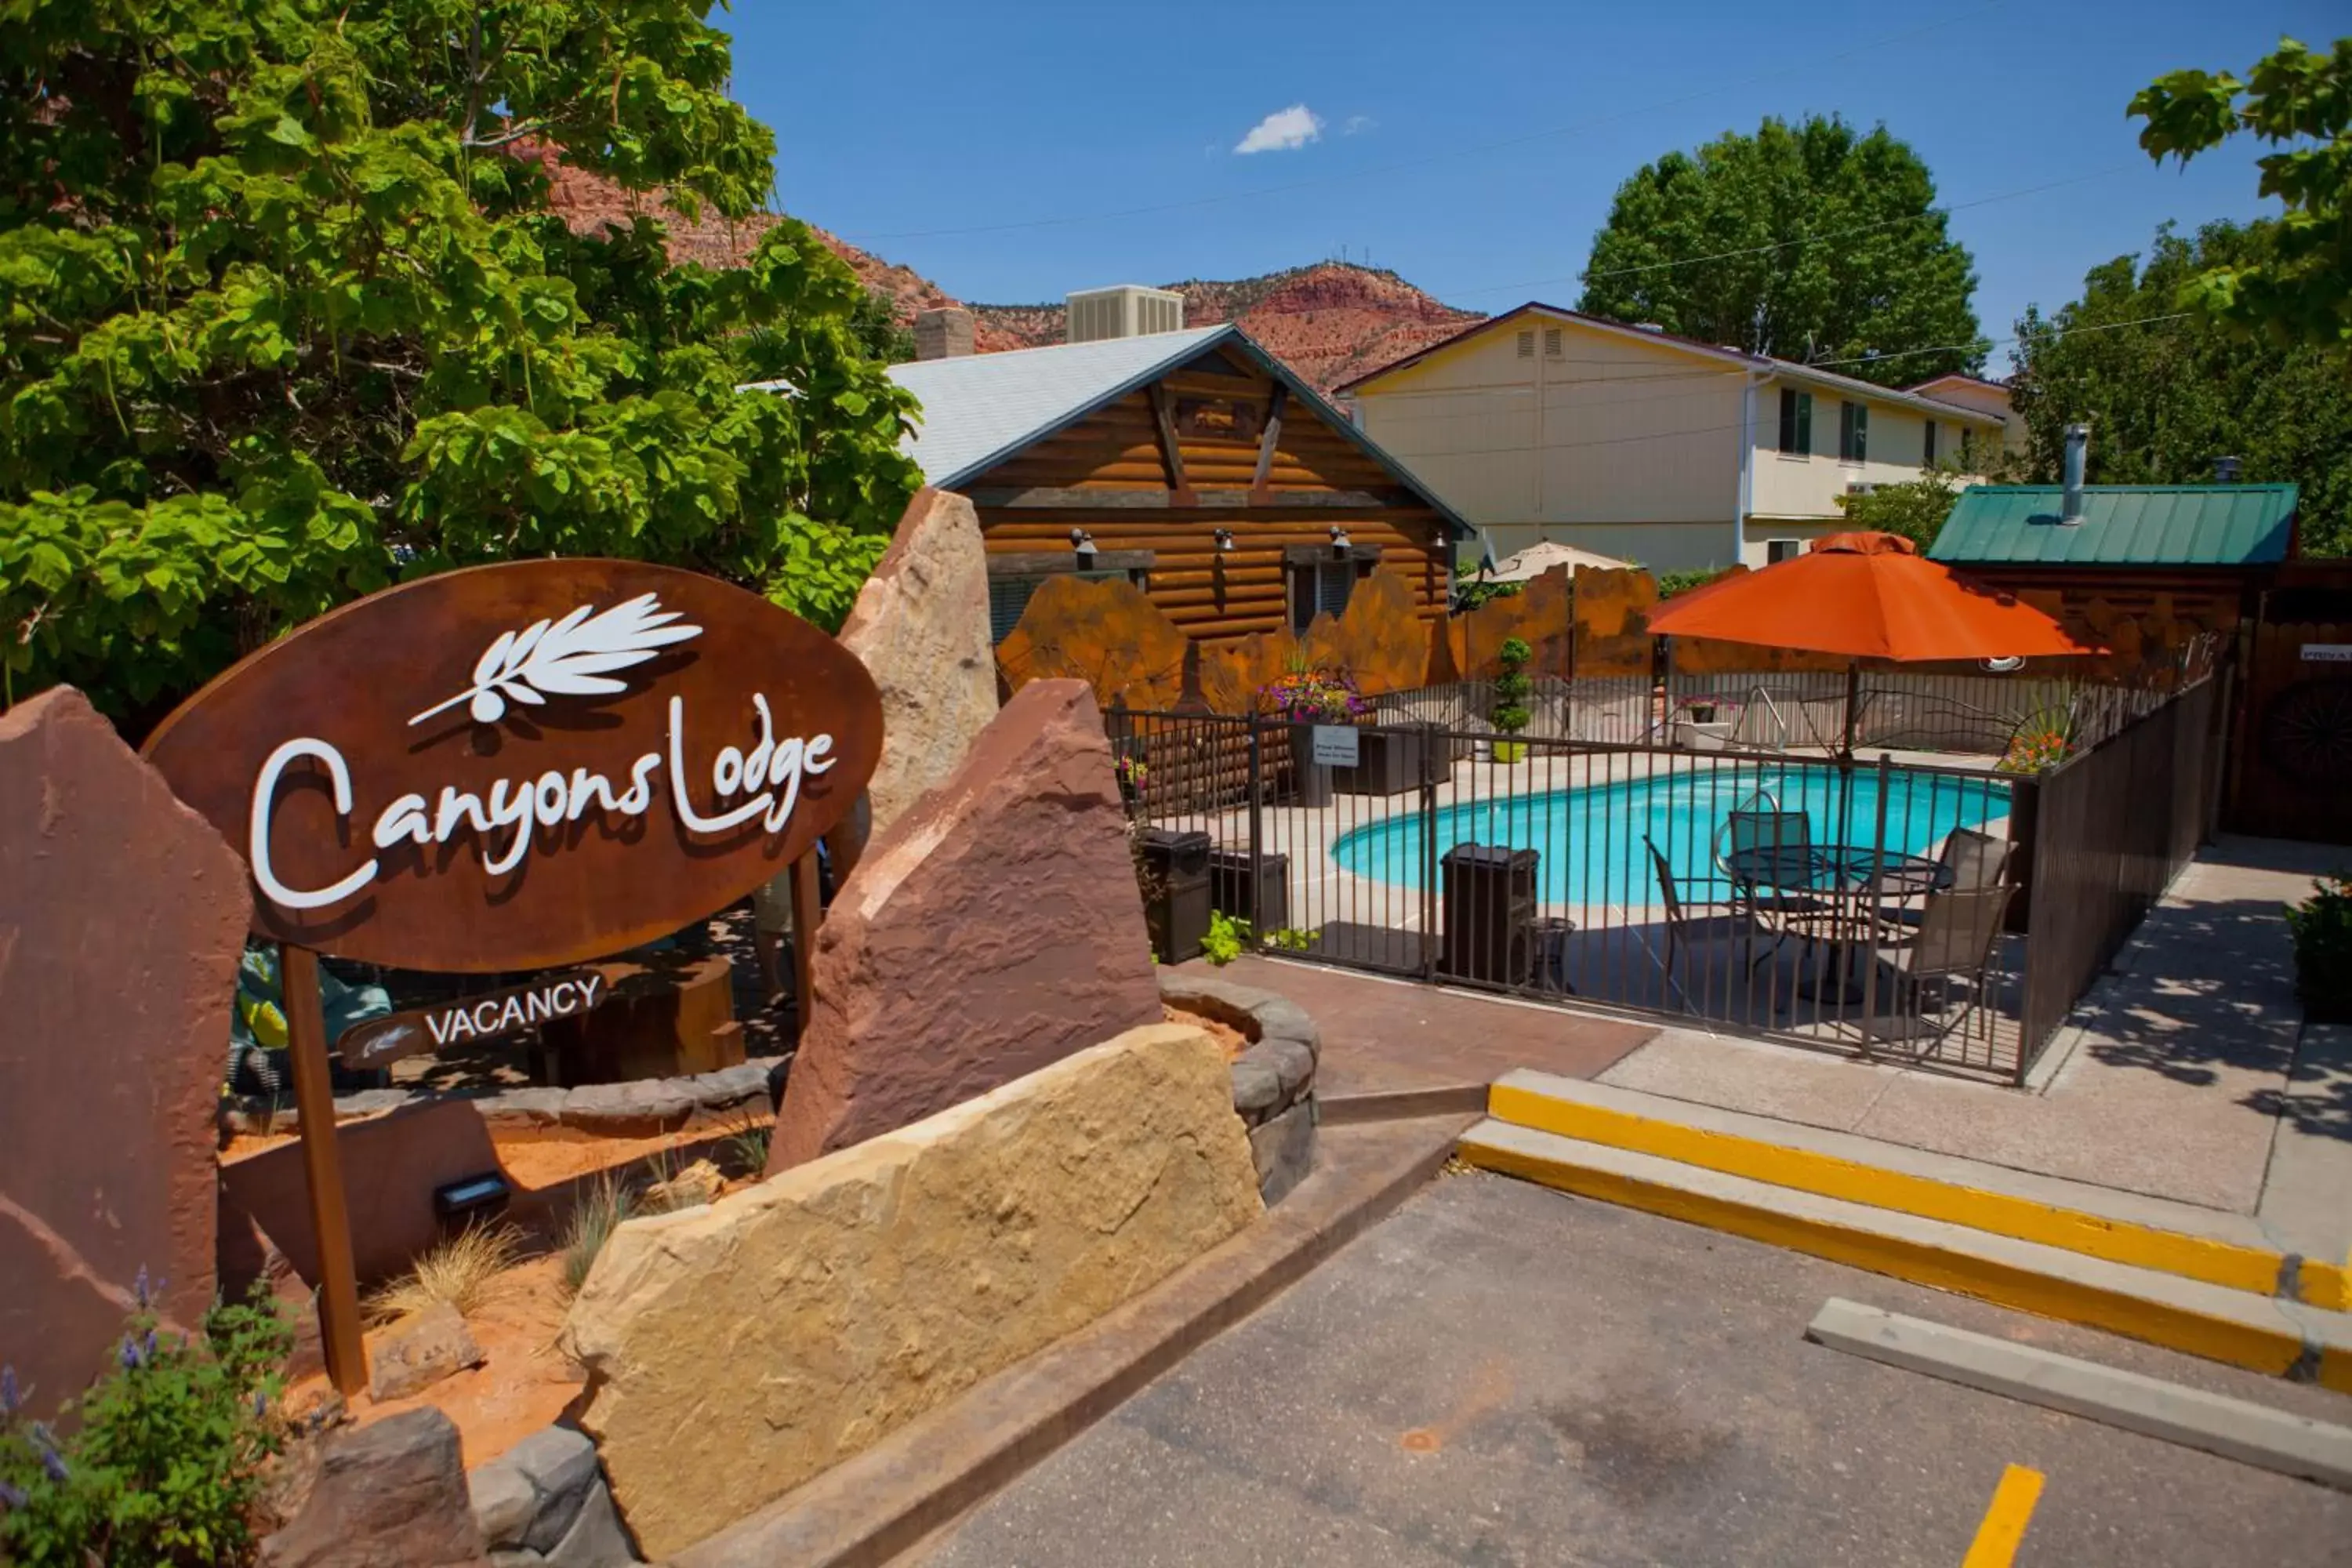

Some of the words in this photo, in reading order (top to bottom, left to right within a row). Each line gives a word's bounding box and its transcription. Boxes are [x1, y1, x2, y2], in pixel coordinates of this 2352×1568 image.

[250, 737, 662, 909] Canyons
[669, 692, 837, 833] Lodge
[425, 976, 601, 1045] VACANCY
